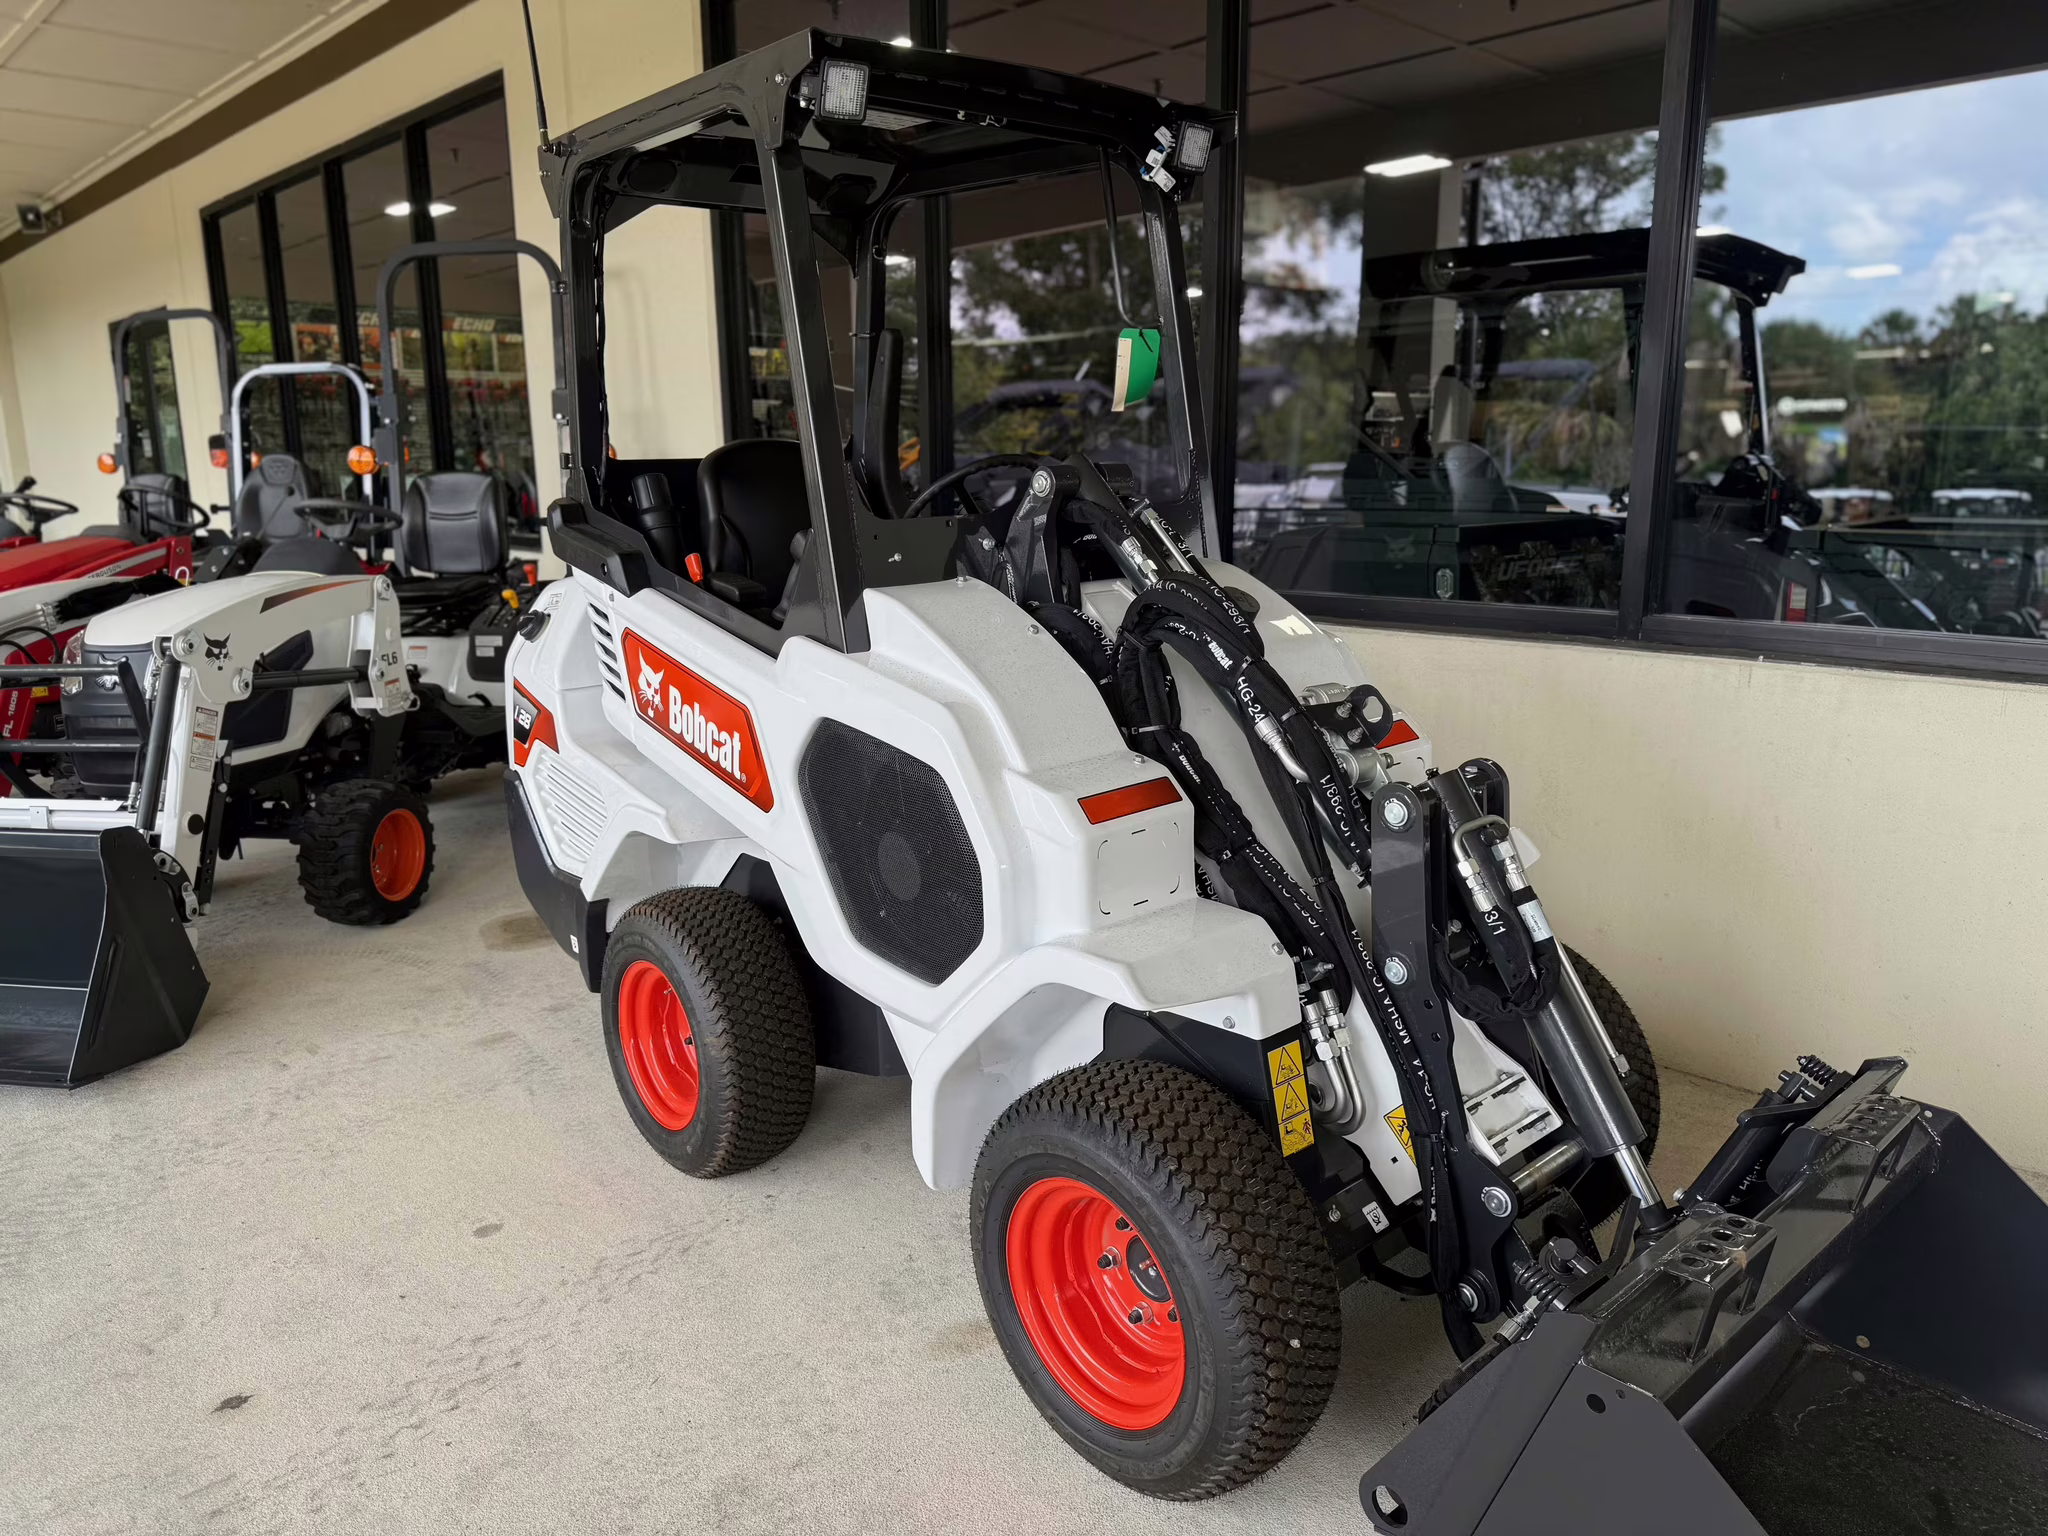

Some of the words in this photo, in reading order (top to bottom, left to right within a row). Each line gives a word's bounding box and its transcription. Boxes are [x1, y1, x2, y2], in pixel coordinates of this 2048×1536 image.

[452, 317, 497, 332] ECHO
[1237, 676, 1266, 723] HG-24
[669, 684, 742, 781] Bobcat
